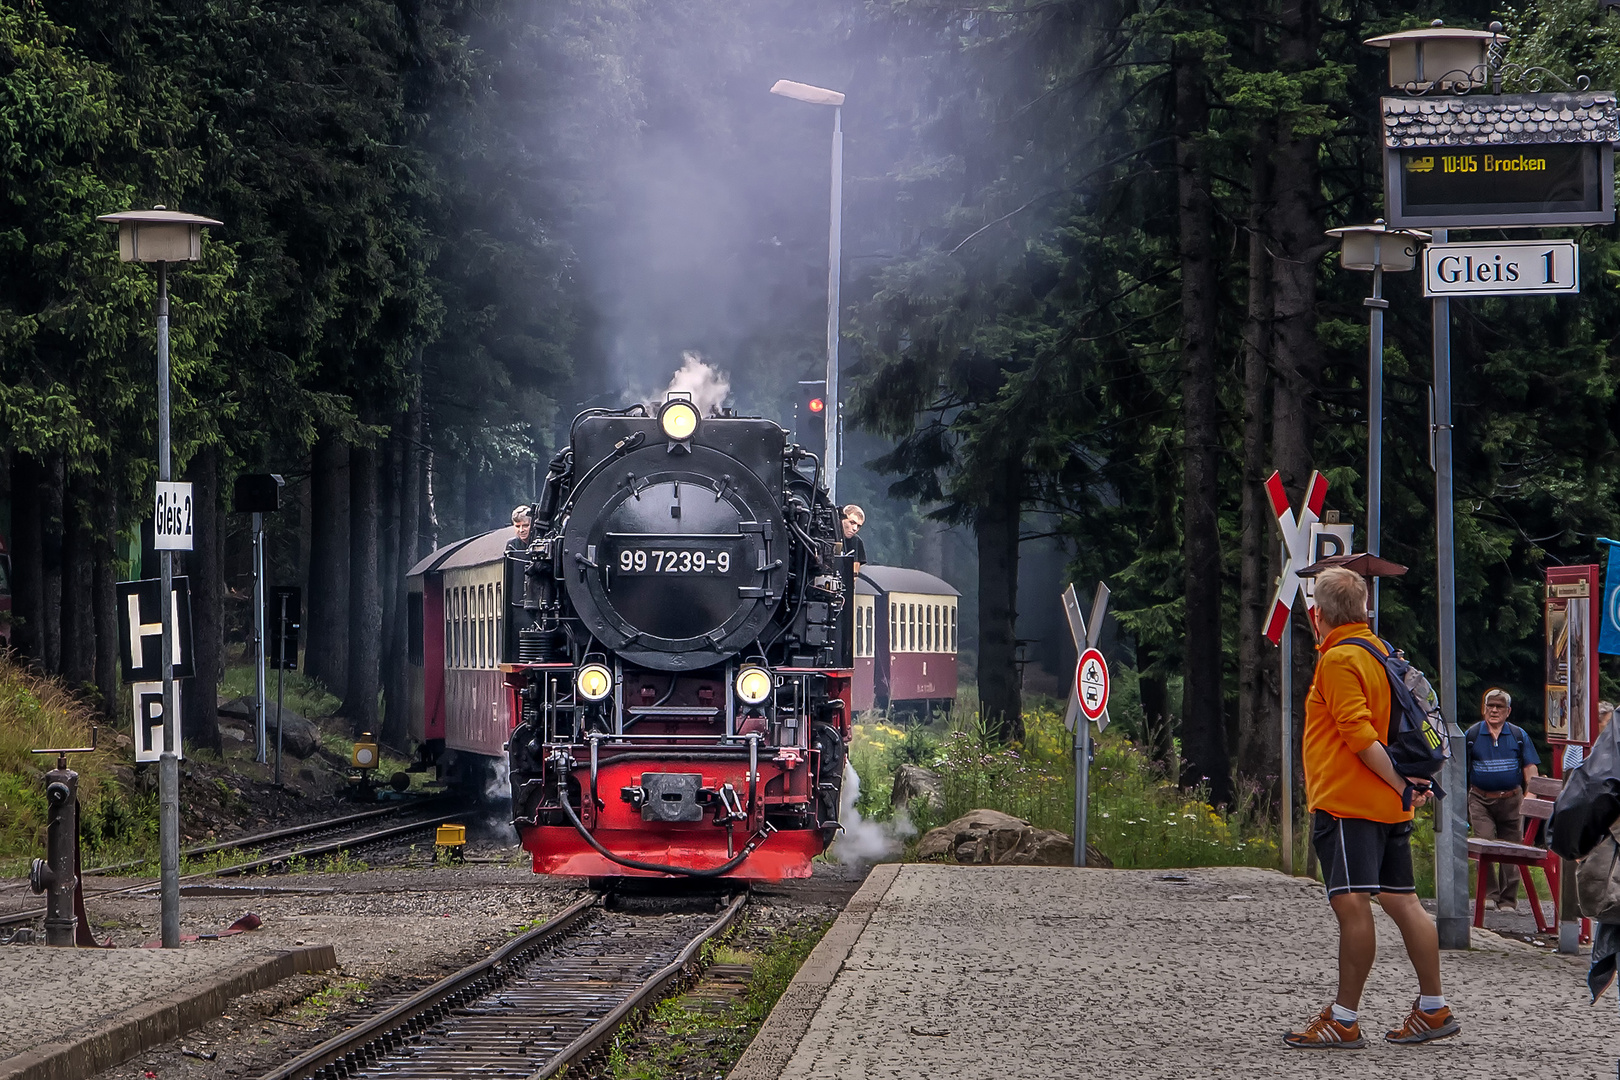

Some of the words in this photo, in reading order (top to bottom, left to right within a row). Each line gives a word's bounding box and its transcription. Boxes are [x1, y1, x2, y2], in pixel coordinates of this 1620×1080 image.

[1442, 155, 1478, 173] 10:05
[1484, 154, 1546, 172] Brocken
[1437, 254, 1520, 284] Gleis
[1541, 249, 1559, 285] 1
[156, 492, 182, 535] Gleis
[184, 495, 192, 535] 2
[620, 550, 647, 572] 99
[651, 550, 730, 573] 7239-9
[127, 590, 182, 669] H
[140, 692, 164, 752] P
